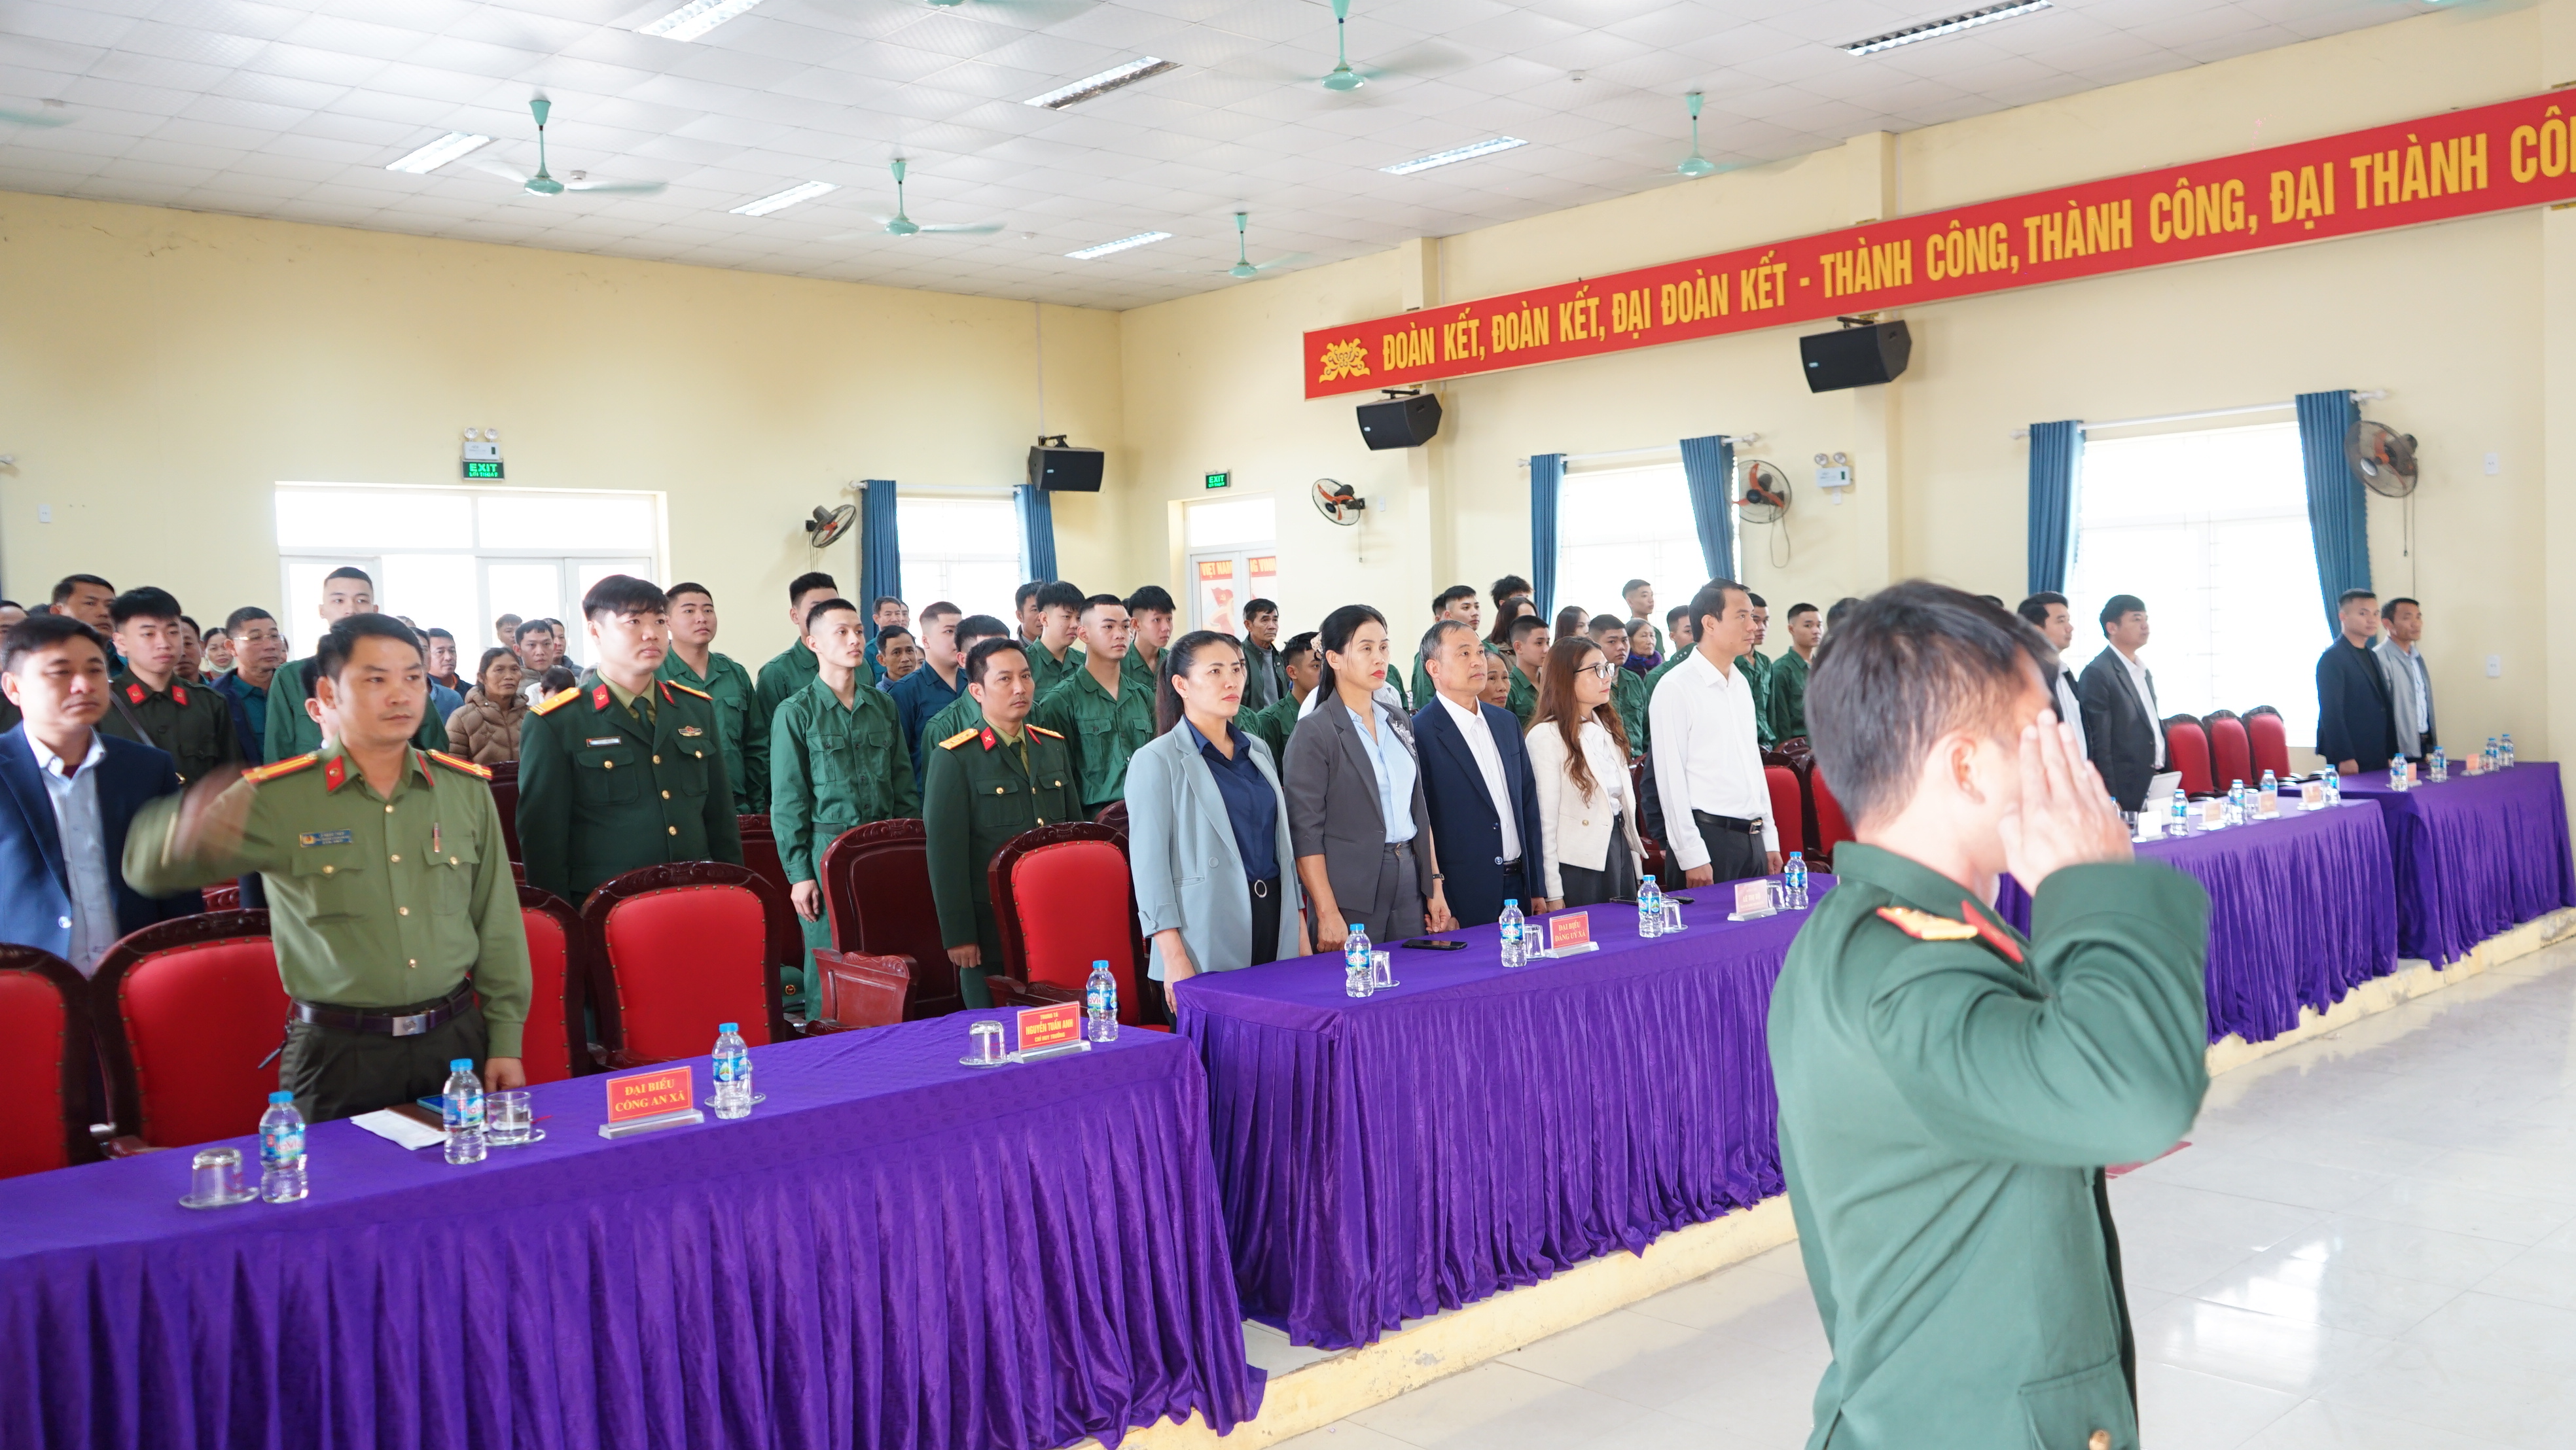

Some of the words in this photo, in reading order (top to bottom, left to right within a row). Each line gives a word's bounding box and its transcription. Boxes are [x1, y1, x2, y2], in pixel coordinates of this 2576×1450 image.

[1383, 322, 1435, 370] ĐOÀN
[1444, 308, 1484, 361] KẾT,
[1492, 301, 1549, 353] ĐOÀN
[1560, 285, 1605, 342] KẾT,
[1612, 288, 1651, 339] ĐẠI
[1661, 269, 1728, 325] ĐOÀN
[1741, 251, 1787, 311] KẾT
[1820, 238, 1912, 298] THÀNH
[1927, 220, 2018, 280] CÔNG,
[2024, 200, 2132, 264] THÀNH
[2150, 178, 2257, 243] CÔNG,
[2270, 162, 2334, 229] ĐẠI
[2350, 133, 2487, 209] THÀNH
[469, 463, 497, 472] EXIT
[1209, 474, 1225, 483] EXIT
[1026, 1021, 1047, 1035] NGUYỄN
[1047, 1018, 1062, 1031] TUẤN
[1062, 1019, 1073, 1029] ANH
[624, 1084, 646, 1095] ĐẠI
[648, 1077, 675, 1092] BIỂU
[615, 1099, 649, 1112] CÔNG
[651, 1095, 668, 1106] AN
[670, 1090, 685, 1103] XÃ
